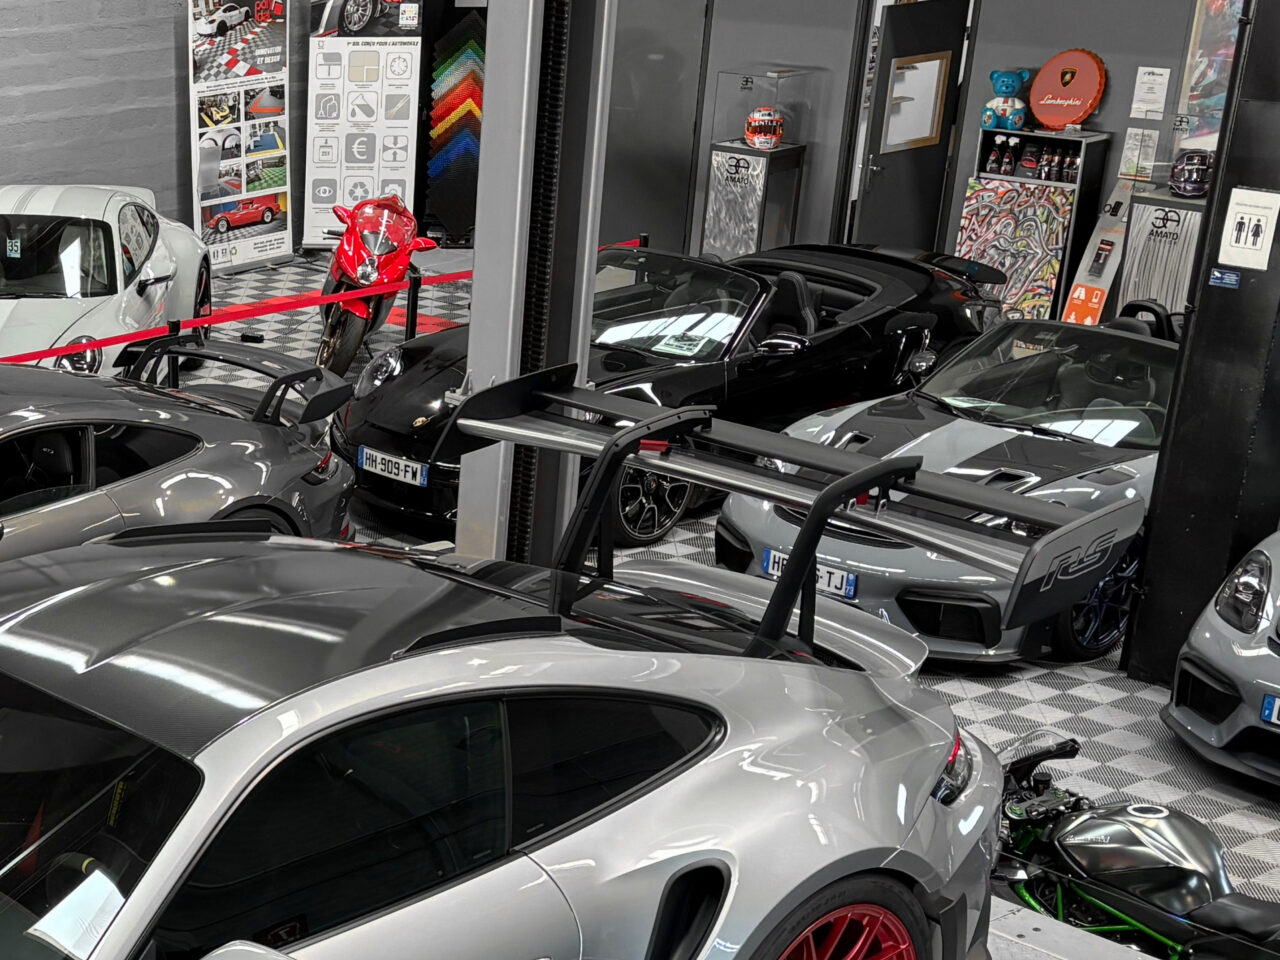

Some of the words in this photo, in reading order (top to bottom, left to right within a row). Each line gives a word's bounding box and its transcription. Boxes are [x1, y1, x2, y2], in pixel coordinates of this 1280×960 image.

[1040, 94, 1083, 107] Lamborghini
[1149, 229, 1179, 241] AMATO
[365, 451, 418, 482] HH-909-FW
[1040, 528, 1119, 592] RS
